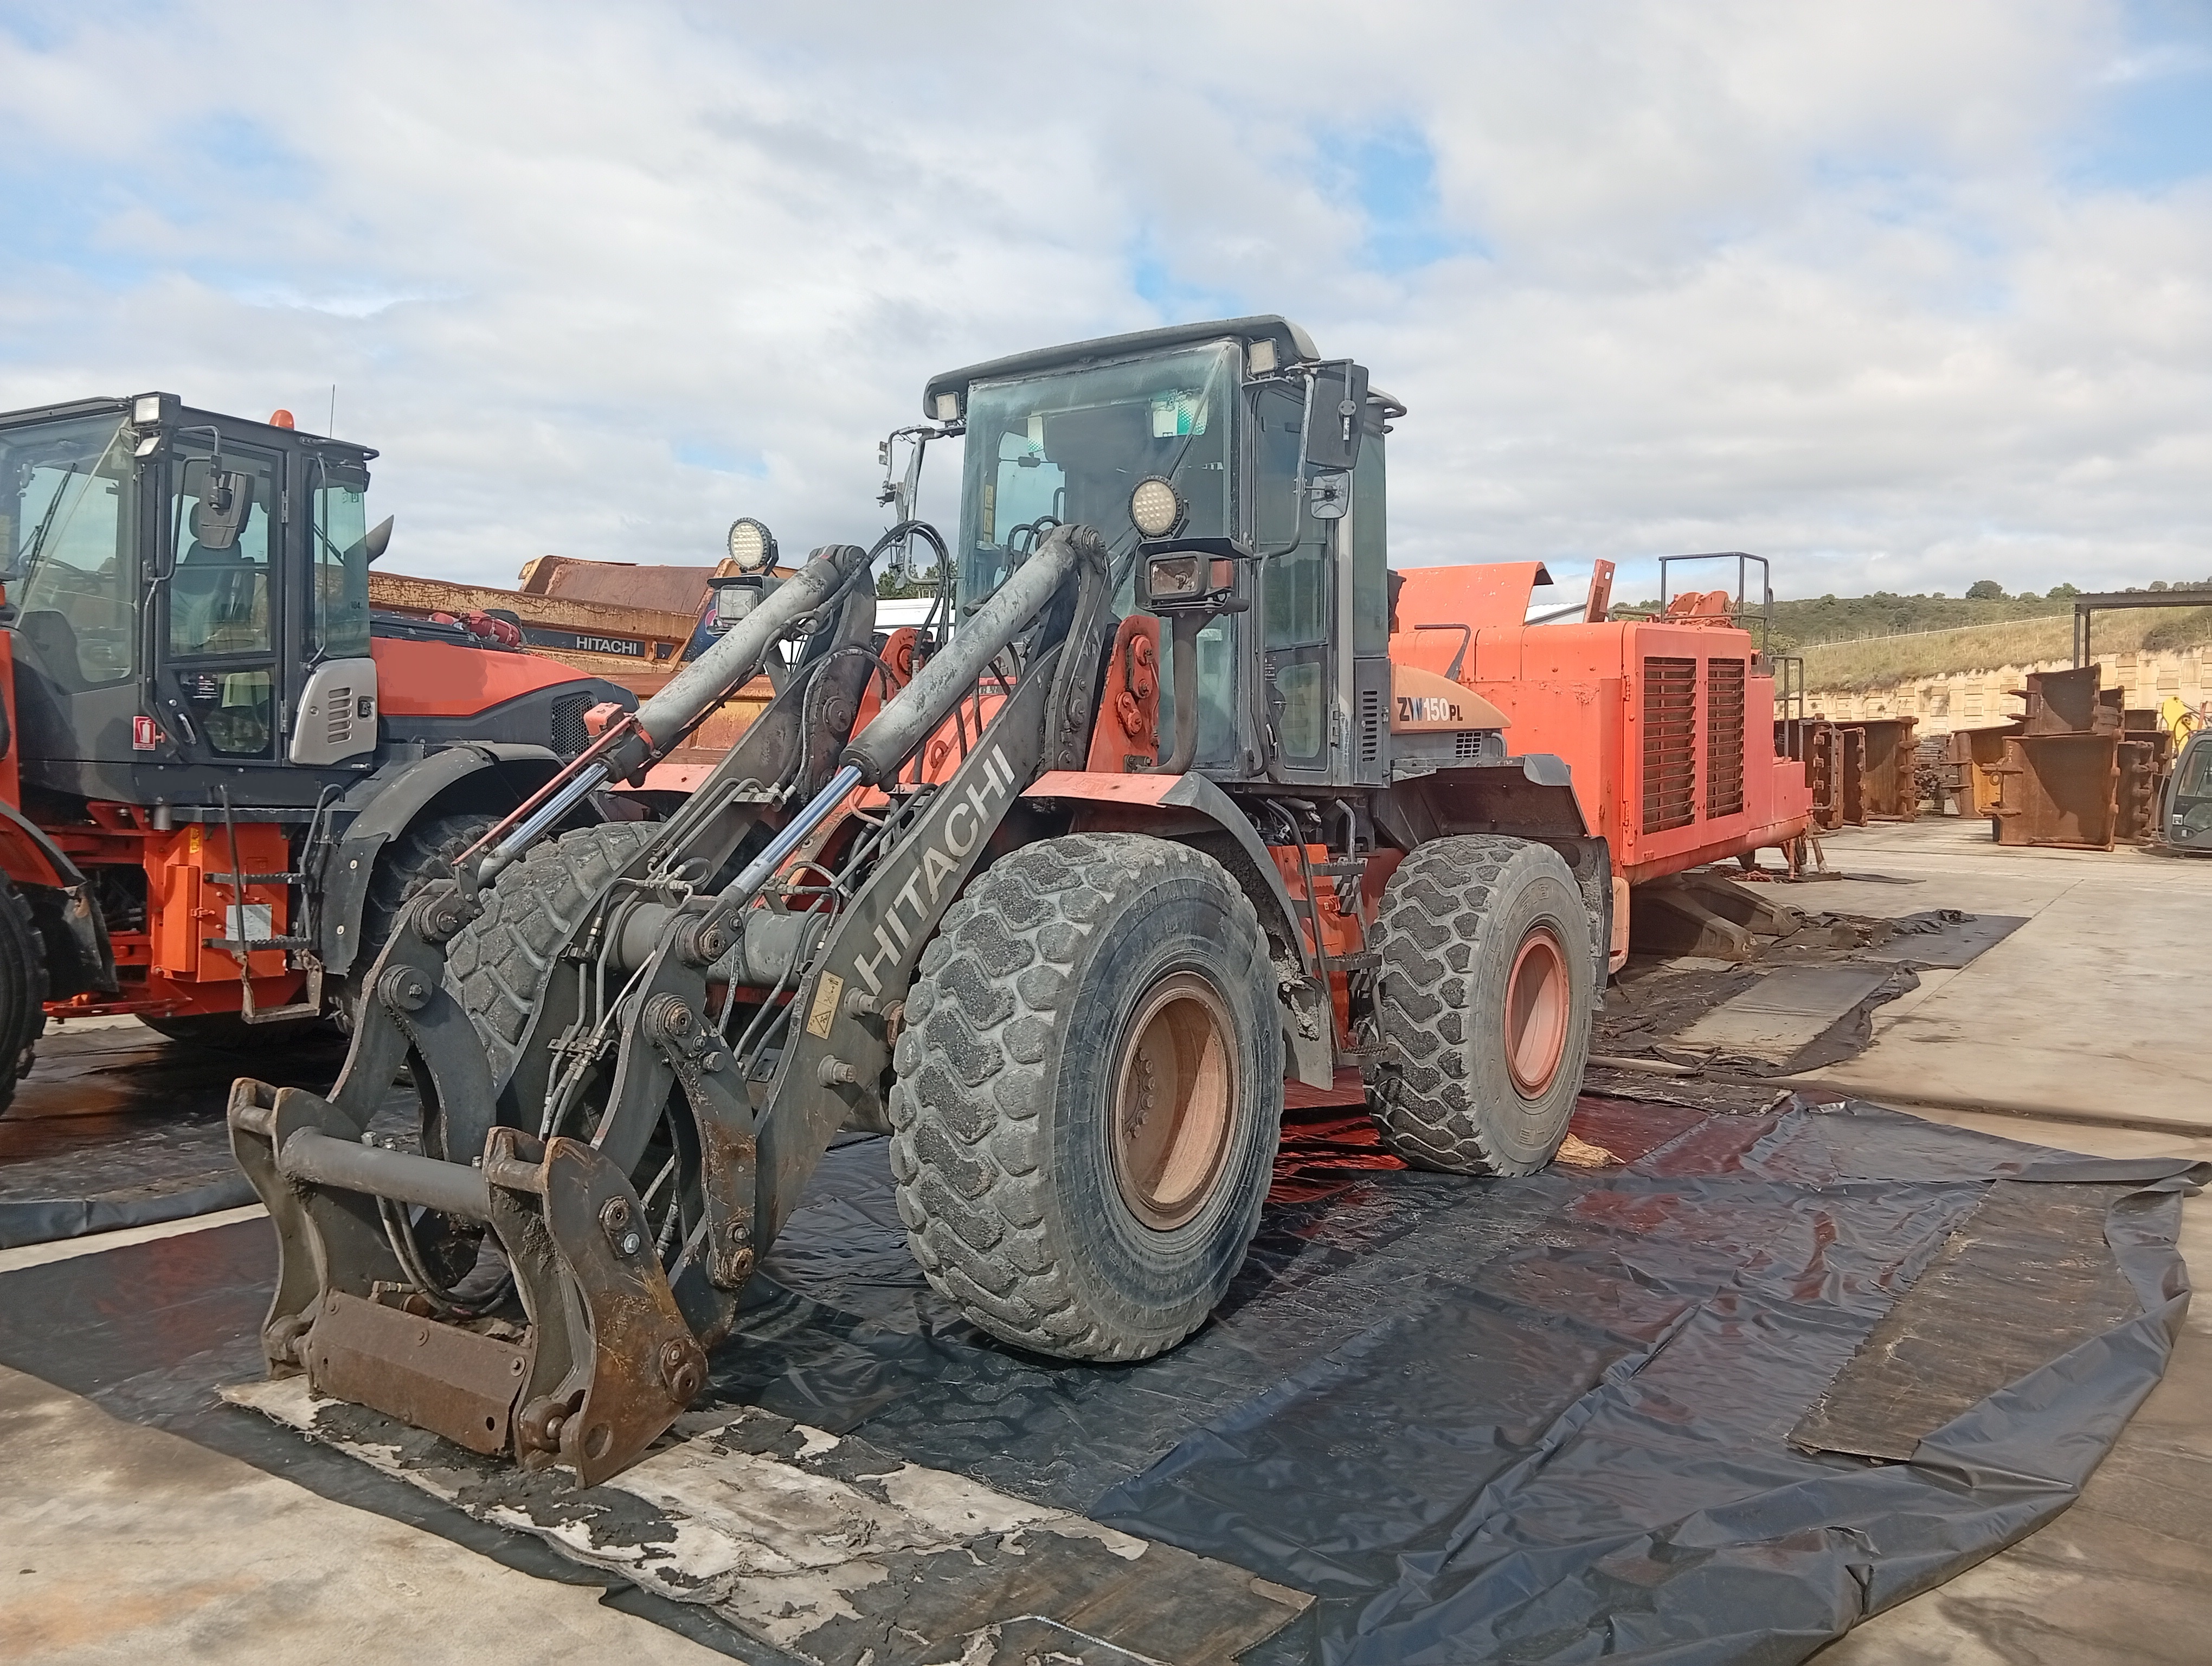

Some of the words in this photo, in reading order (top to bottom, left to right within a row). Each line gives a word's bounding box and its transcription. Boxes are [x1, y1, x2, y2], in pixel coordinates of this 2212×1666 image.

[576, 636, 638, 655] HITACHI
[1397, 697, 1463, 721] ZW150PL
[853, 743, 1015, 996] HITACHI
